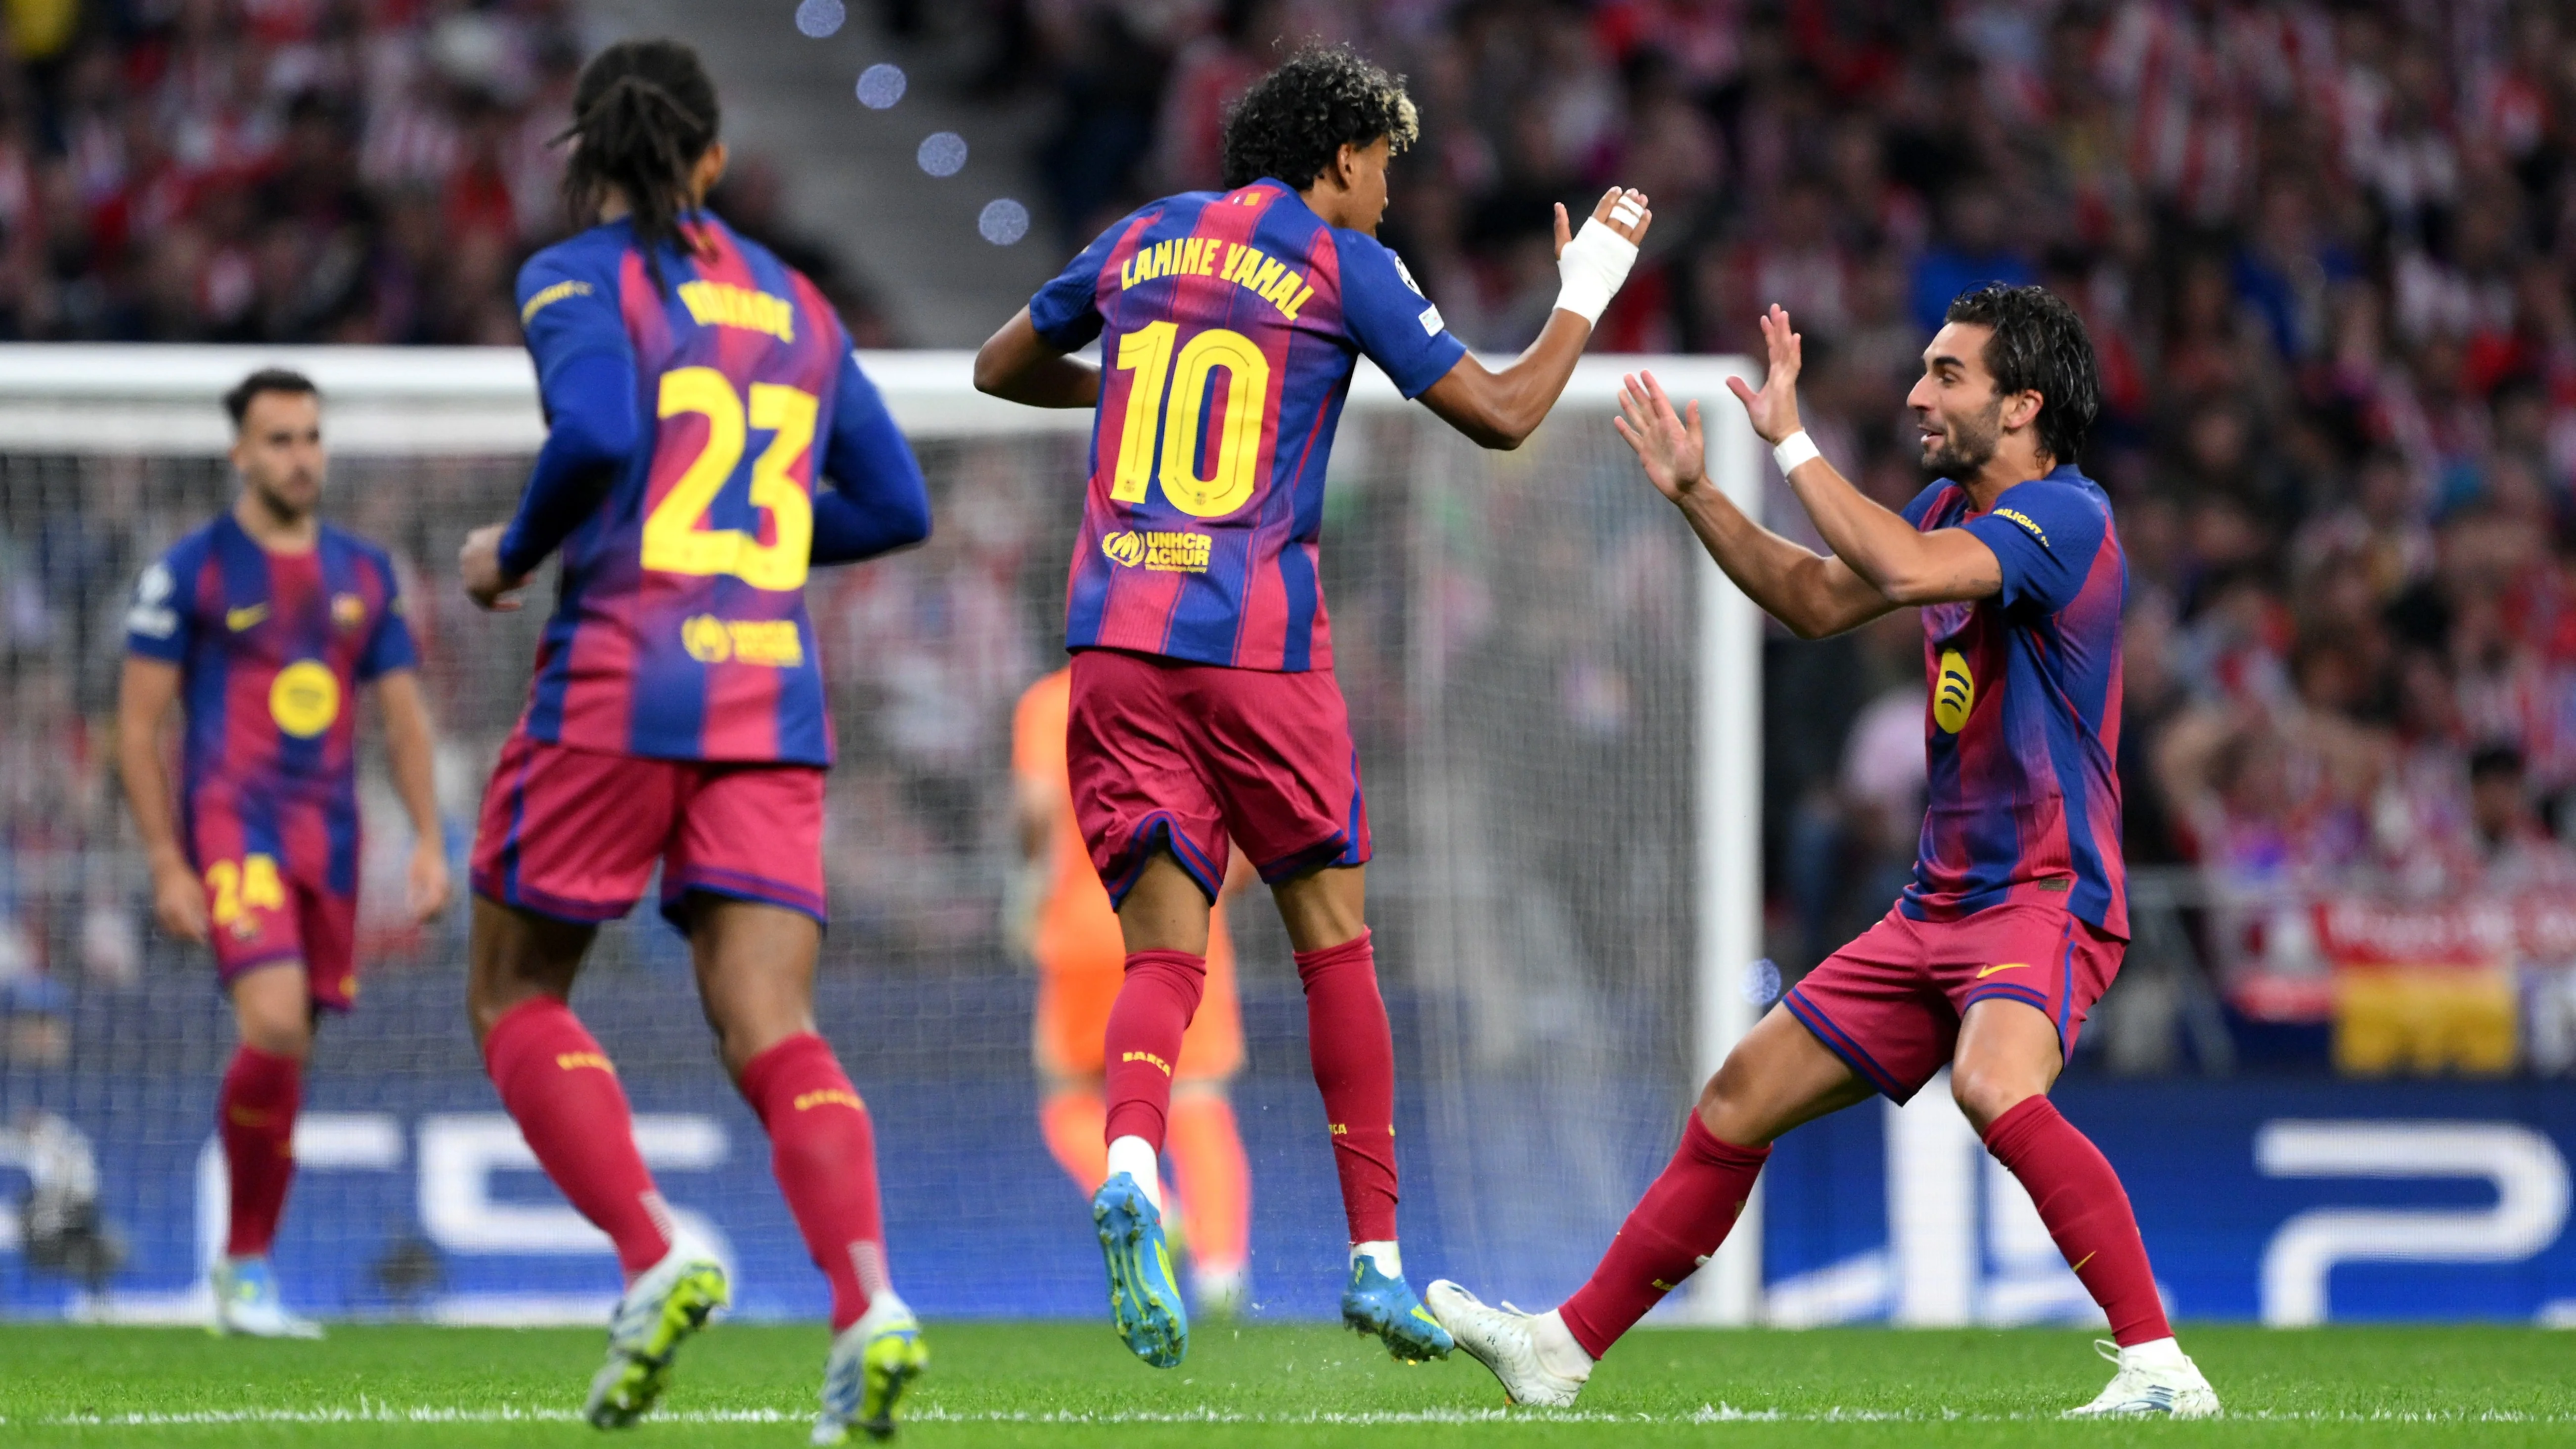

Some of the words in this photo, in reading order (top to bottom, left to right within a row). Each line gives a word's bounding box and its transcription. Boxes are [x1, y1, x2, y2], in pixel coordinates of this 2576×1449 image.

[1121, 237, 1222, 291] LAMINE
[1220, 243, 1315, 321] YAMAL
[1110, 320, 1270, 517] 10
[640, 365, 819, 591] 23
[1145, 547, 1210, 566] ACNUR
[1146, 531, 1212, 550] UNHCR
[205, 854, 285, 925] 24
